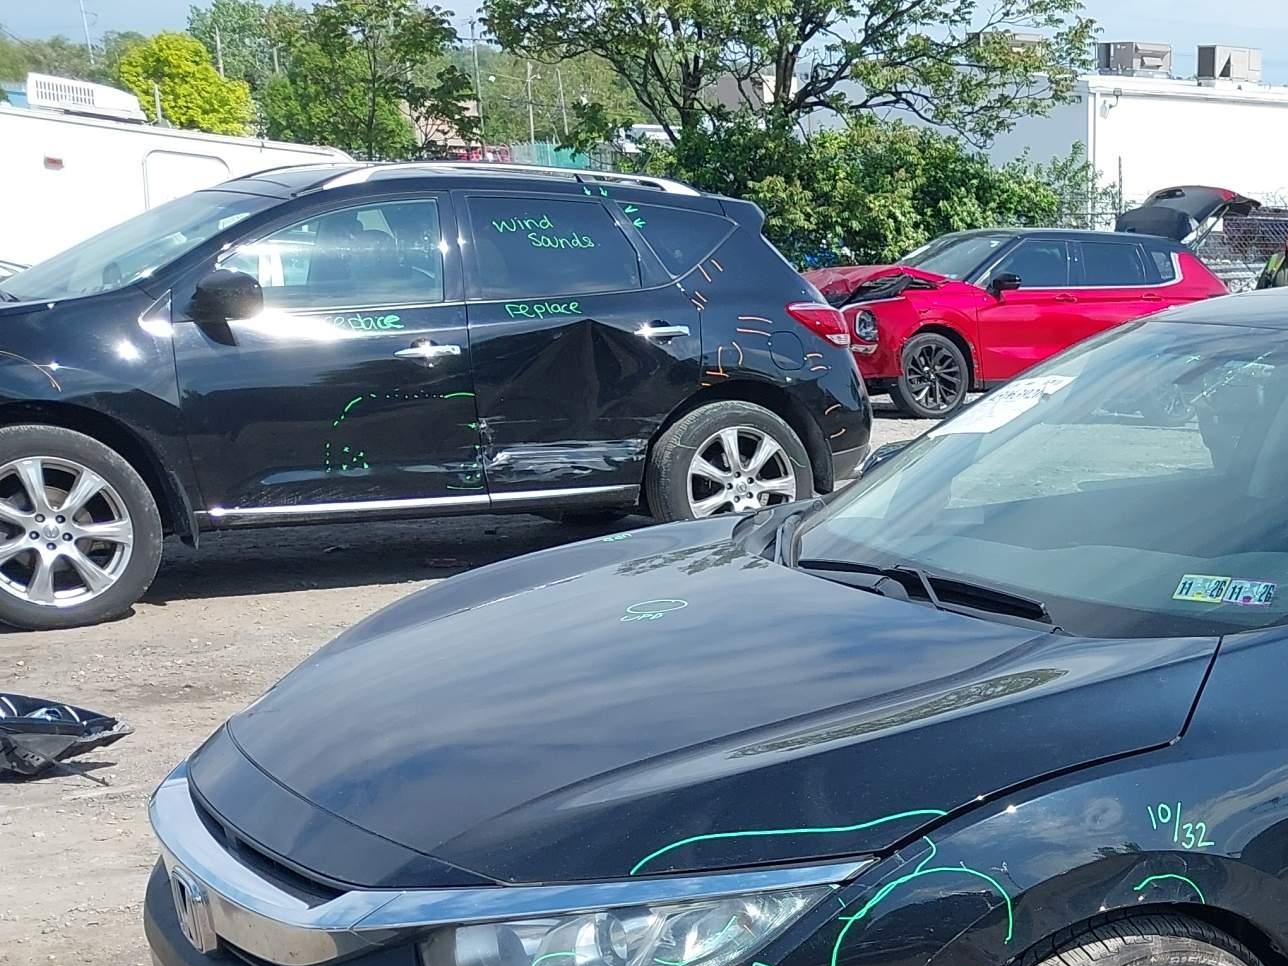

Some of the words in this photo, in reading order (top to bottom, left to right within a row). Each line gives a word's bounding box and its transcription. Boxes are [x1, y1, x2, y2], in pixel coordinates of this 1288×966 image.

[1179, 581, 1194, 596] 11
[1209, 580, 1227, 599] 26
[1228, 585, 1244, 601] 11
[1258, 583, 1275, 602] 26
[1147, 802, 1215, 849] 10/32
